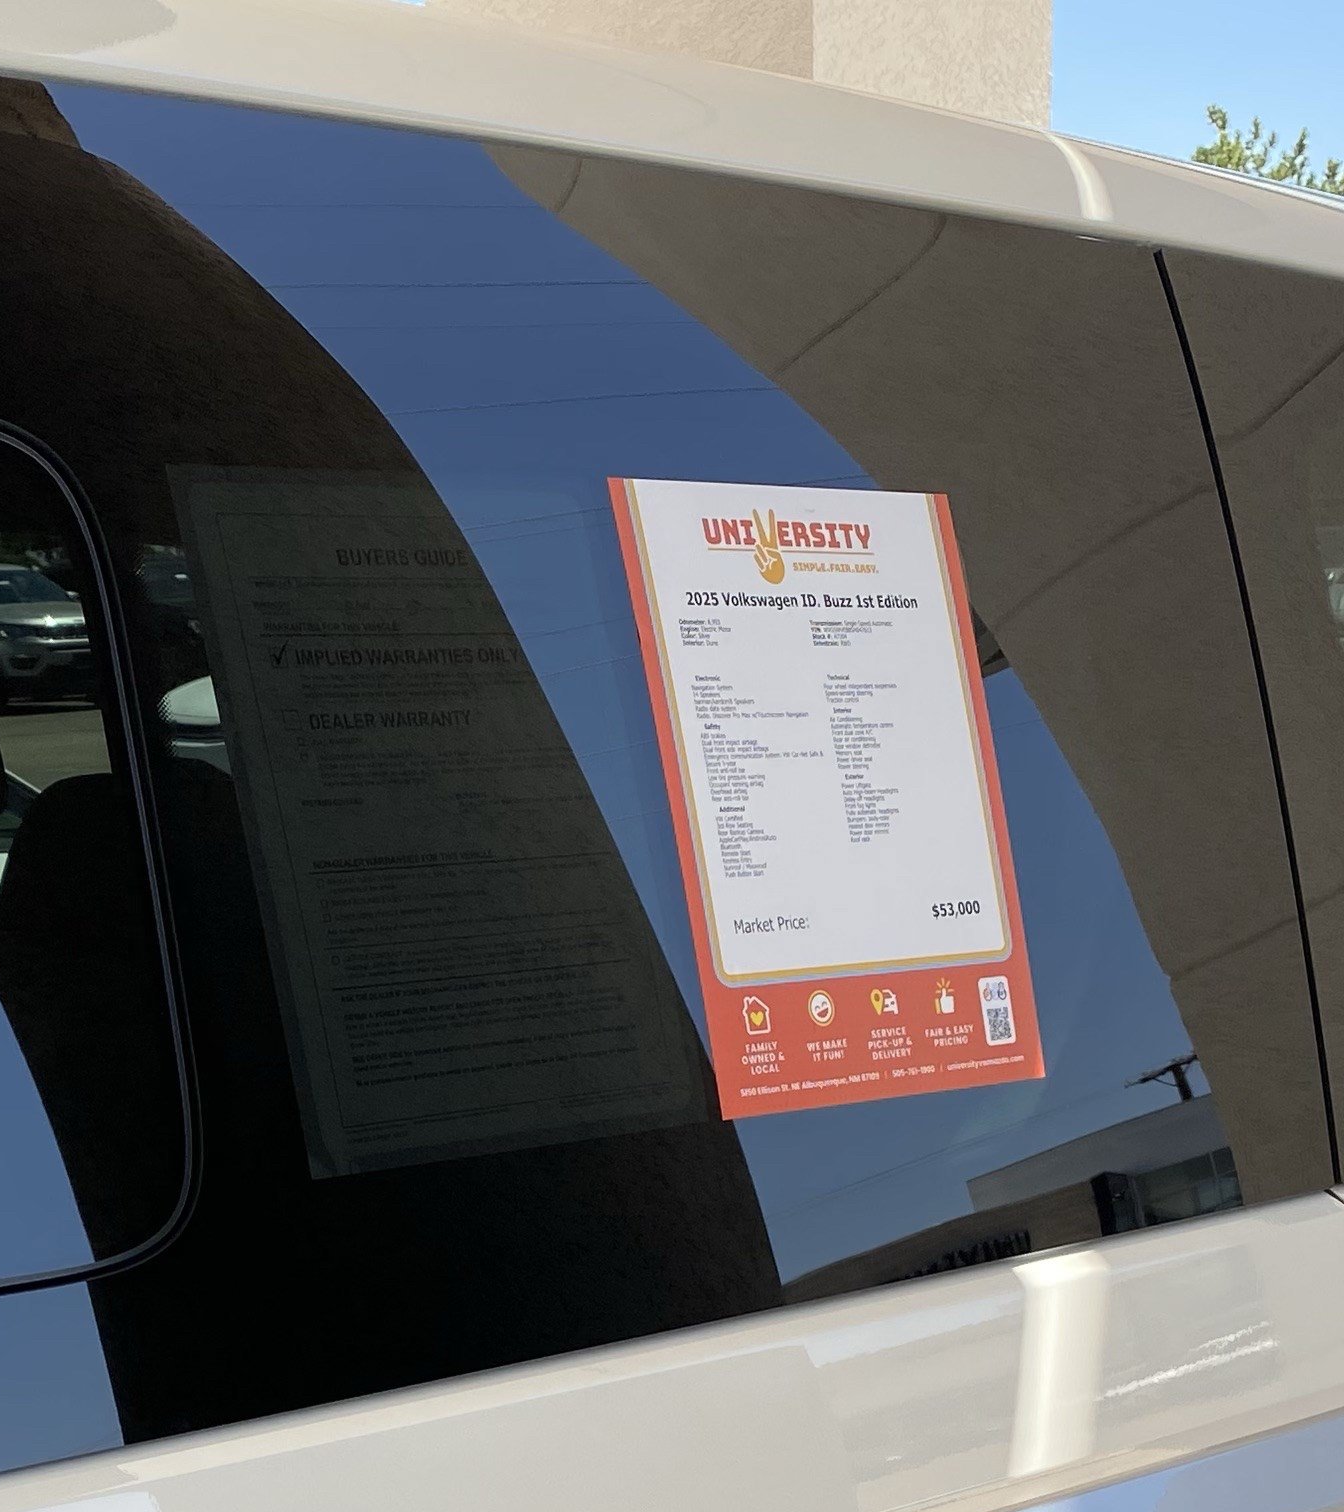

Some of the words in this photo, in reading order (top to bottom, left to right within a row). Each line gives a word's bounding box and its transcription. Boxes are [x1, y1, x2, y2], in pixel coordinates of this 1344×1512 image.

[701, 510, 871, 551] UNIVERSITY
[335, 548, 410, 567] BUYERS
[413, 547, 470, 567] GUIDE
[685, 591, 719, 606] 2025
[721, 591, 799, 611] Volkswagen
[801, 593, 822, 608] ID.
[823, 594, 853, 609] Buzz
[855, 594, 875, 609] 1st
[877, 594, 918, 610] Edition
[294, 647, 364, 667] IMPLIED
[365, 647, 473, 666] WARRANTIES
[476, 646, 521, 664] ONLY
[308, 711, 376, 731] DEALER
[379, 708, 472, 729] WARRANTY
[931, 899, 981, 920] $53,000
[733, 917, 775, 935] Market
[777, 915, 810, 932] Price:
[870, 1026, 907, 1039] SERVICE
[924, 1028, 945, 1038] FAIR
[945, 1026, 952, 1036] &
[953, 1023, 974, 1035] EASY
[745, 1040, 778, 1054] FAMILY
[806, 1040, 821, 1052] WE
[822, 1037, 848, 1050] MAKE
[867, 1037, 904, 1051] PICK-UP
[906, 1036, 914, 1047] &
[933, 1034, 969, 1048] PRICING
[741, 1052, 776, 1065] OWNED
[778, 1051, 786, 1061] &
[812, 1051, 821, 1062] IT
[823, 1050, 845, 1061] FUN!
[871, 1047, 912, 1061] DELIVERY
[750, 1063, 781, 1076] LOCAL
